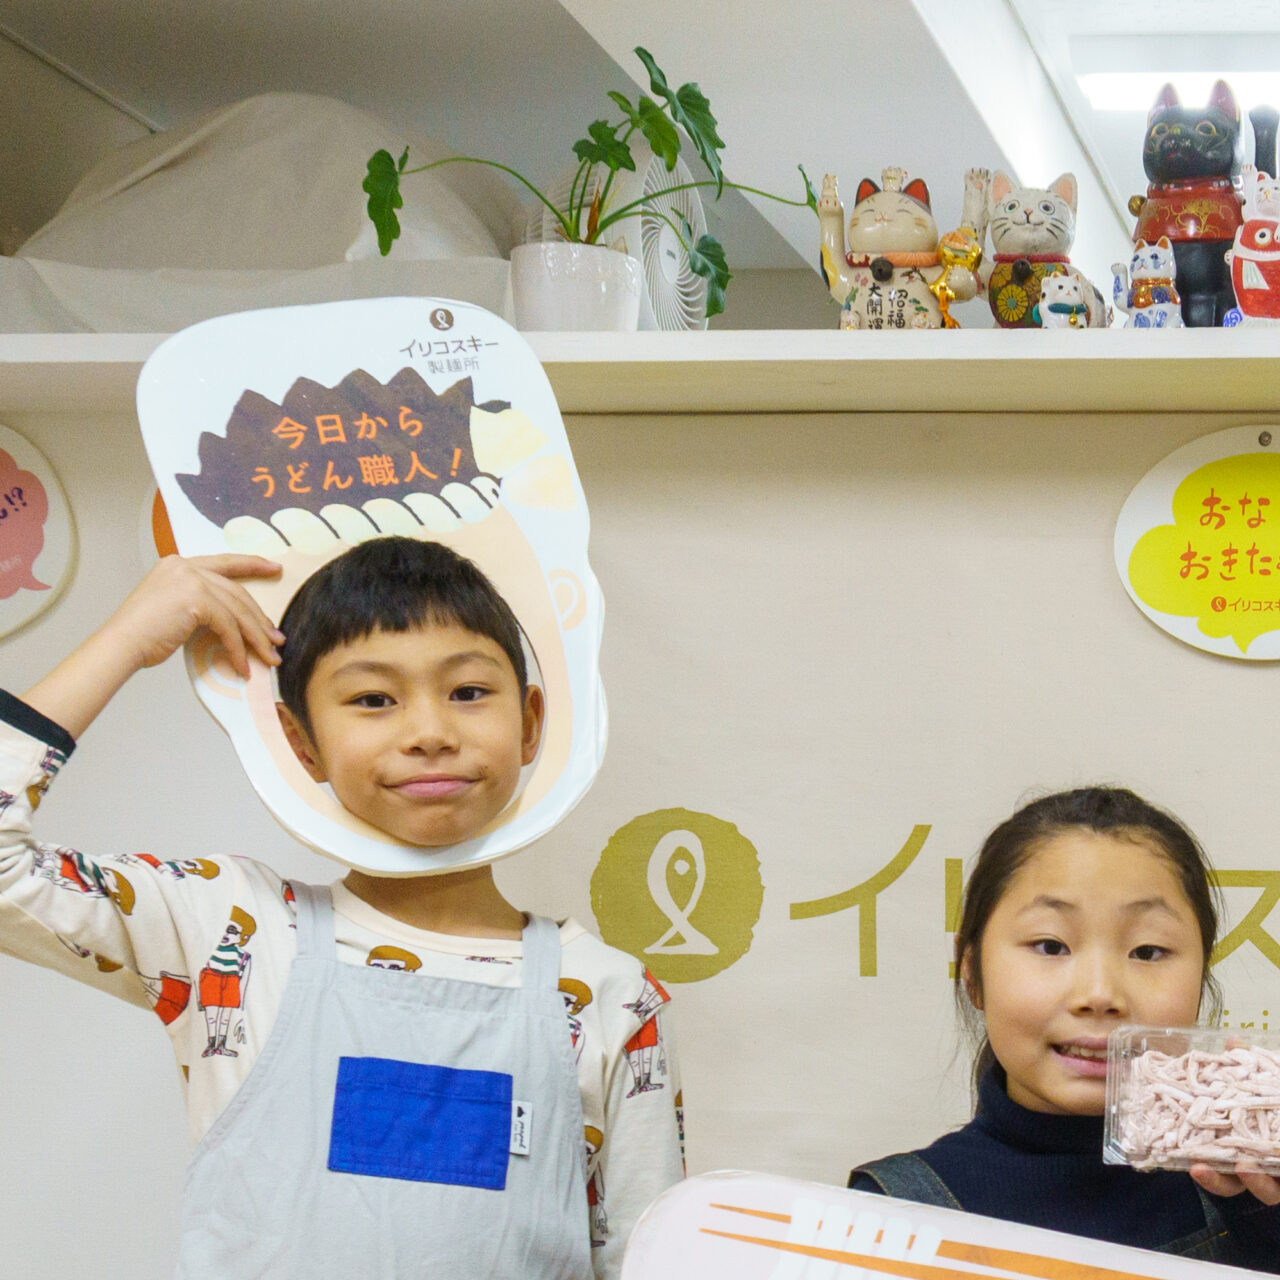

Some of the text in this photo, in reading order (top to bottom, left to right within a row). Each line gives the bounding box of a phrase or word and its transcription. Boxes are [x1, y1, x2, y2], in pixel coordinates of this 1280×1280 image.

[400, 336, 499, 358] イリコスキー
[428, 356, 480, 374] 製麺所
[271, 405, 423, 450] 今日から
[251, 447, 462, 498] うどん職人!
